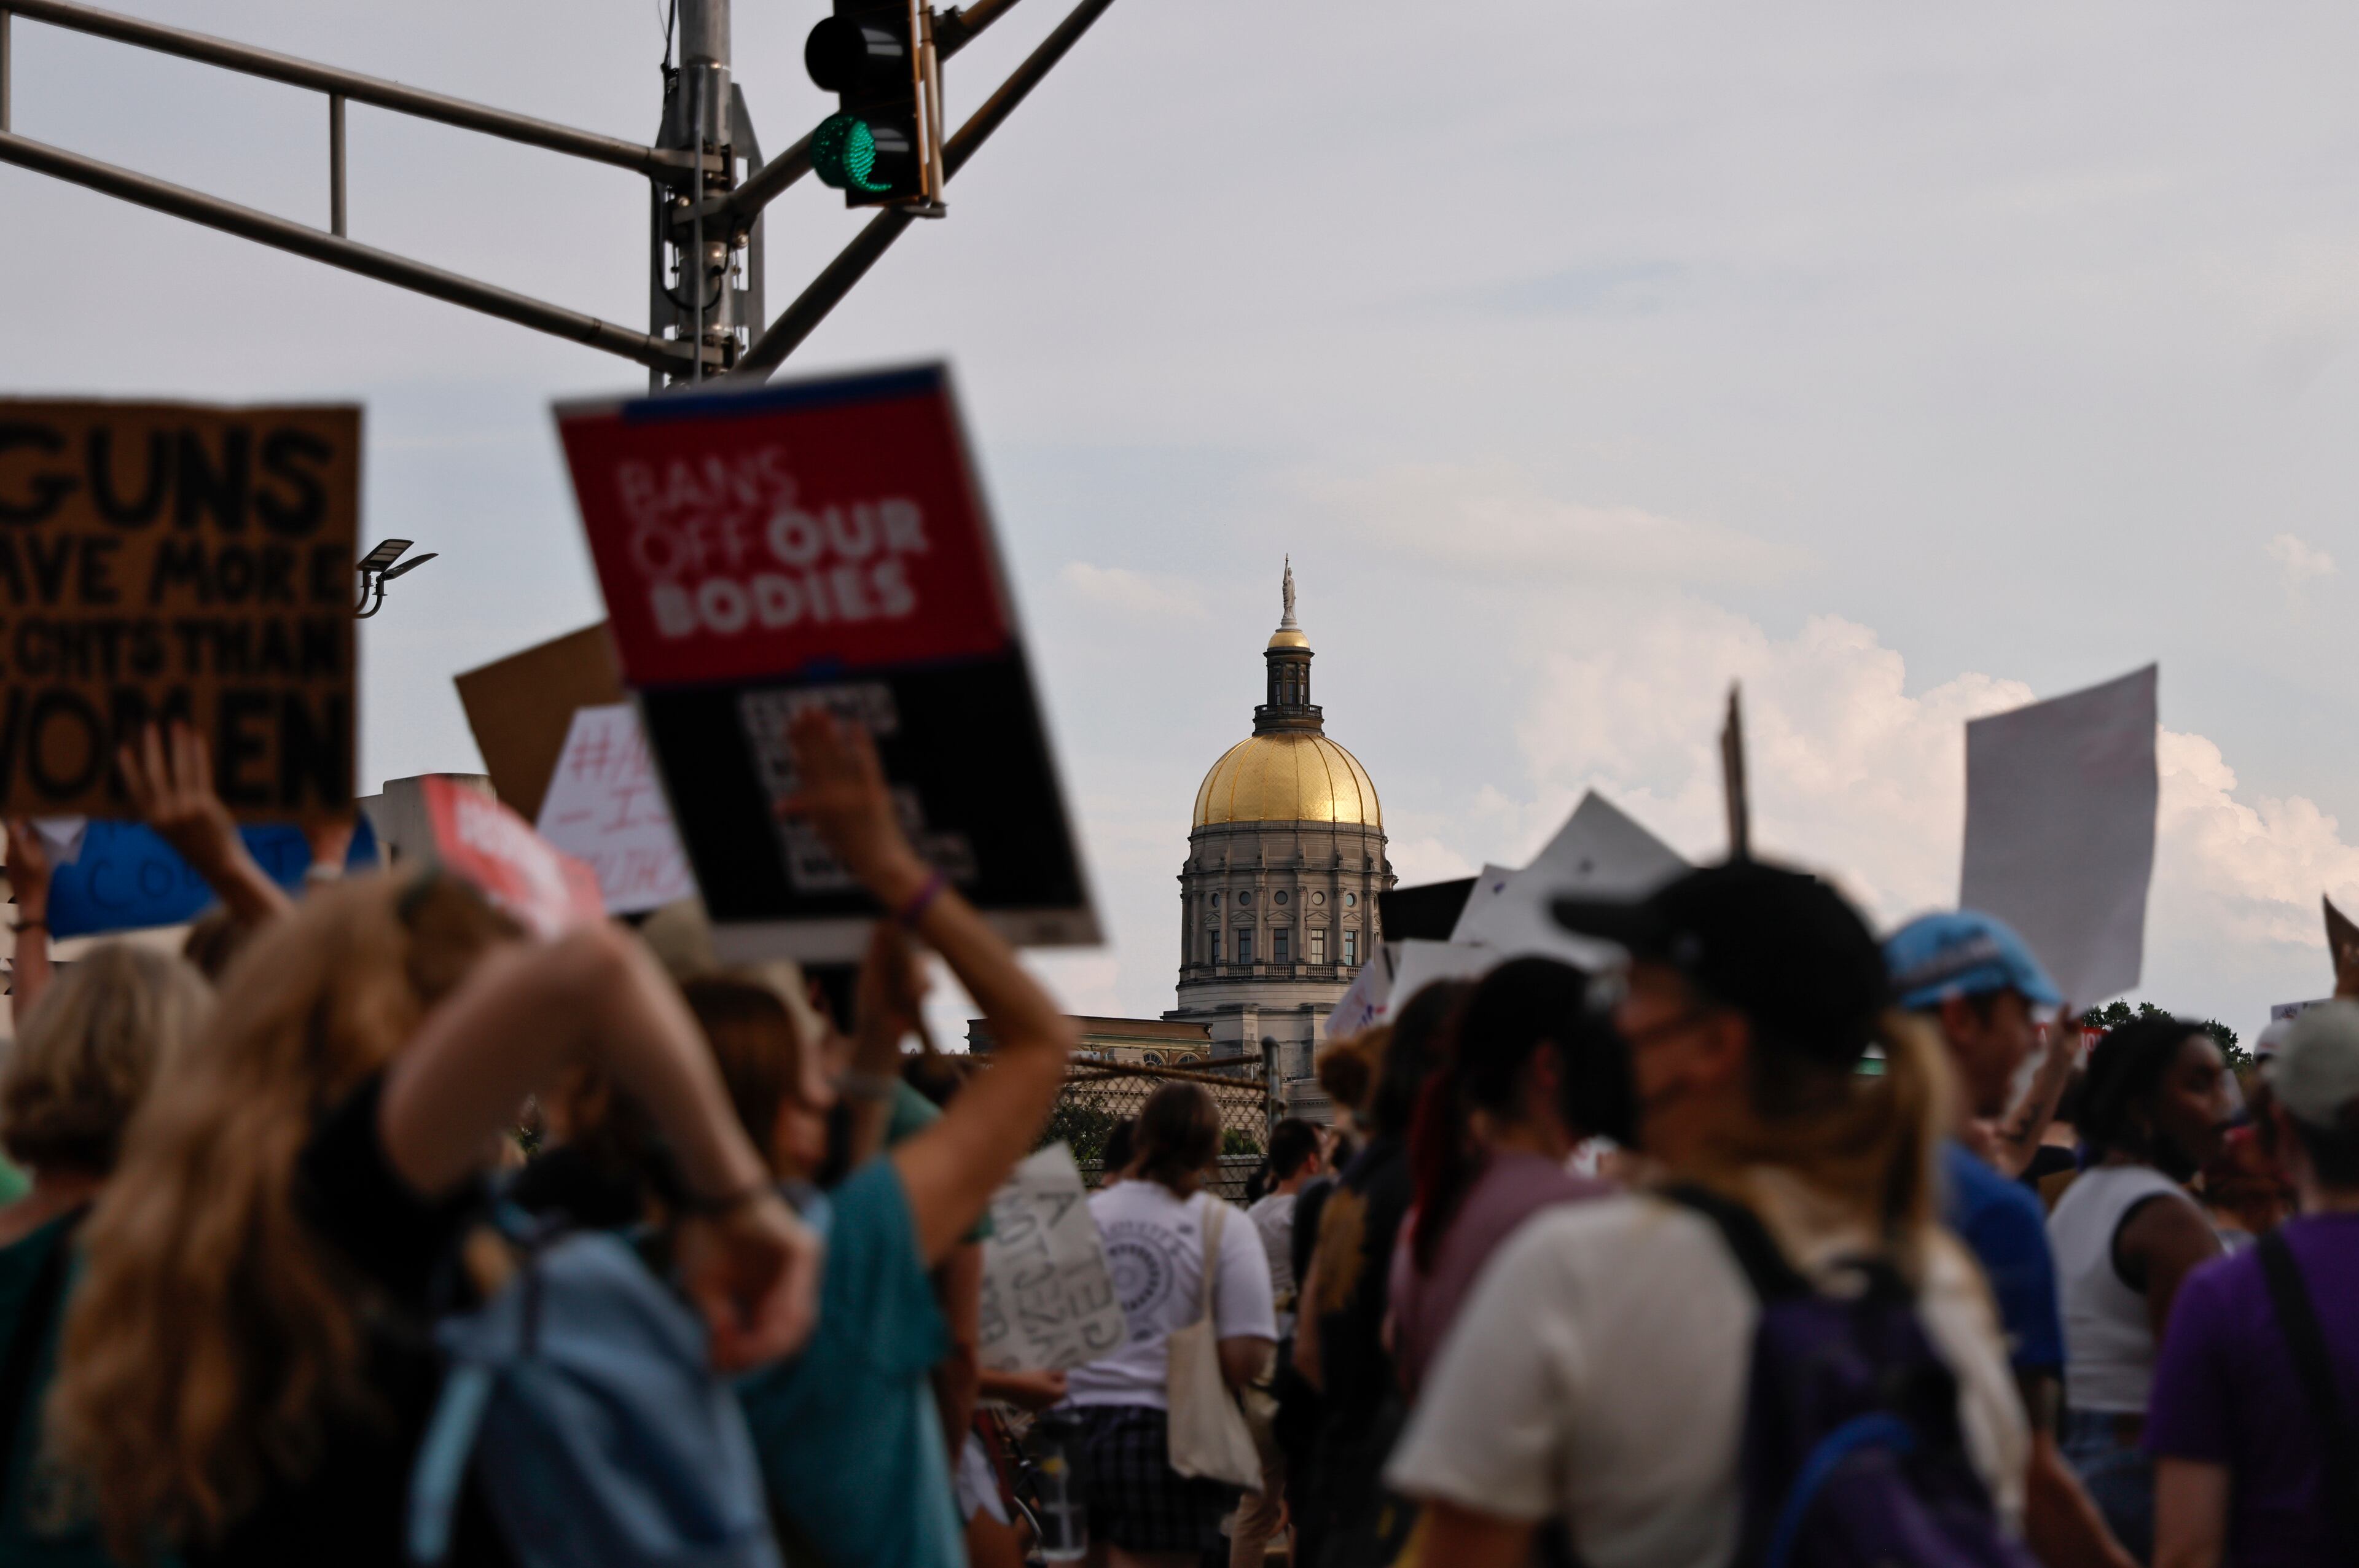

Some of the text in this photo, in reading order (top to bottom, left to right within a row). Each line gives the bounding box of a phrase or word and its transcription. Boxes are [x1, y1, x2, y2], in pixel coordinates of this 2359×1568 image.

[0, 422, 335, 536] GUNS
[616, 443, 799, 517] BANS
[149, 538, 349, 607] MORE
[629, 496, 933, 579] OFF OUR
[651, 554, 919, 640] BODIES
[173, 616, 340, 678] THAN
